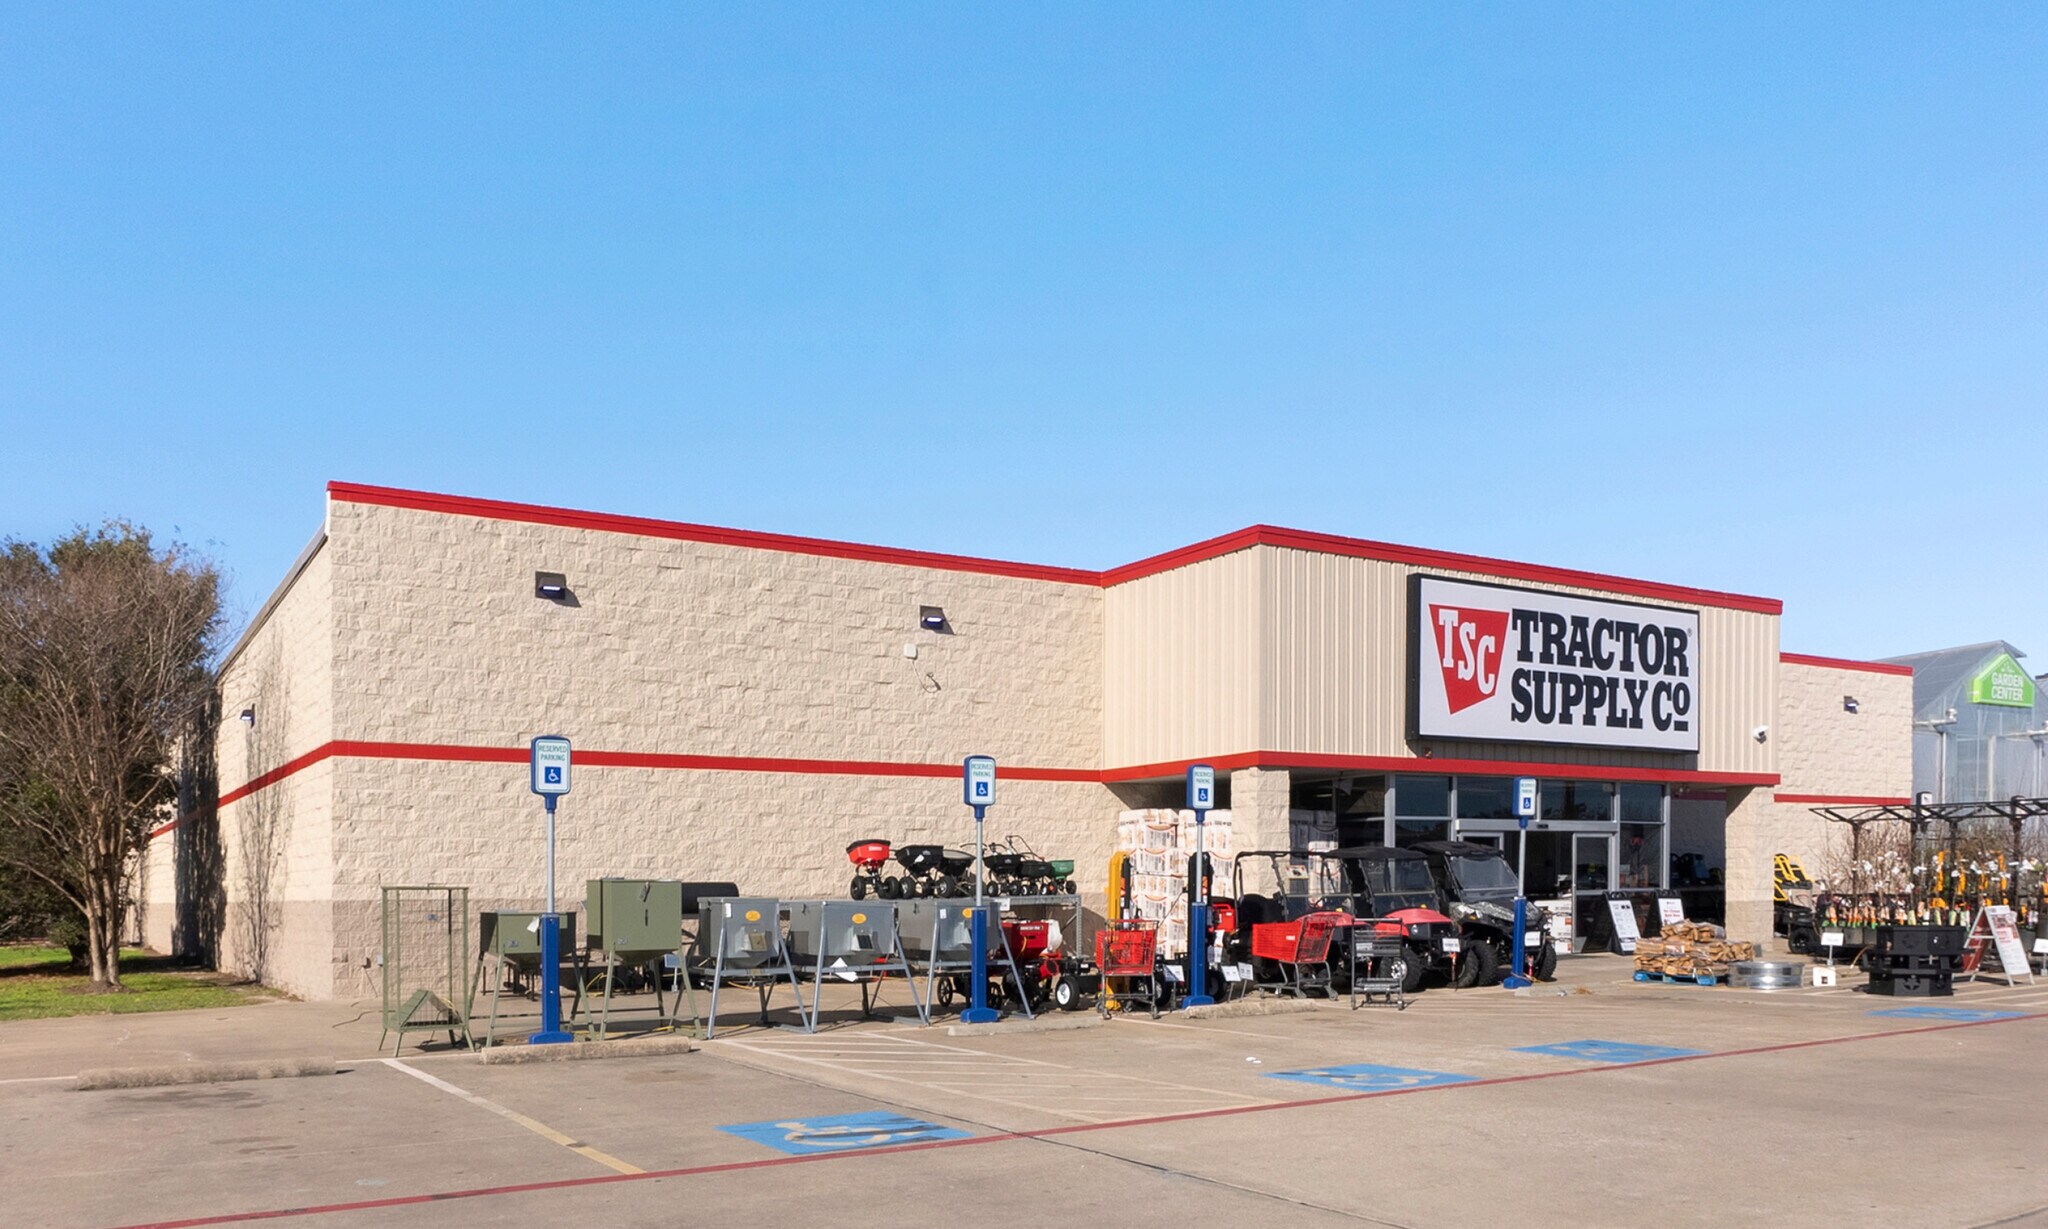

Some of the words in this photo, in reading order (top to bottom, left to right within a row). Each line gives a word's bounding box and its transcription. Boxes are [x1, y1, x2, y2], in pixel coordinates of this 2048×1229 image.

[1511, 608, 1689, 677] TRACTOR
[1438, 608, 1496, 695] TSC
[1991, 672, 2024, 688] GARDEN
[1511, 667, 1649, 730] SUPPLY
[1991, 685, 2024, 702] CENTER
[538, 744, 568, 753] RESERVED
[540, 753, 566, 761] PARKING
